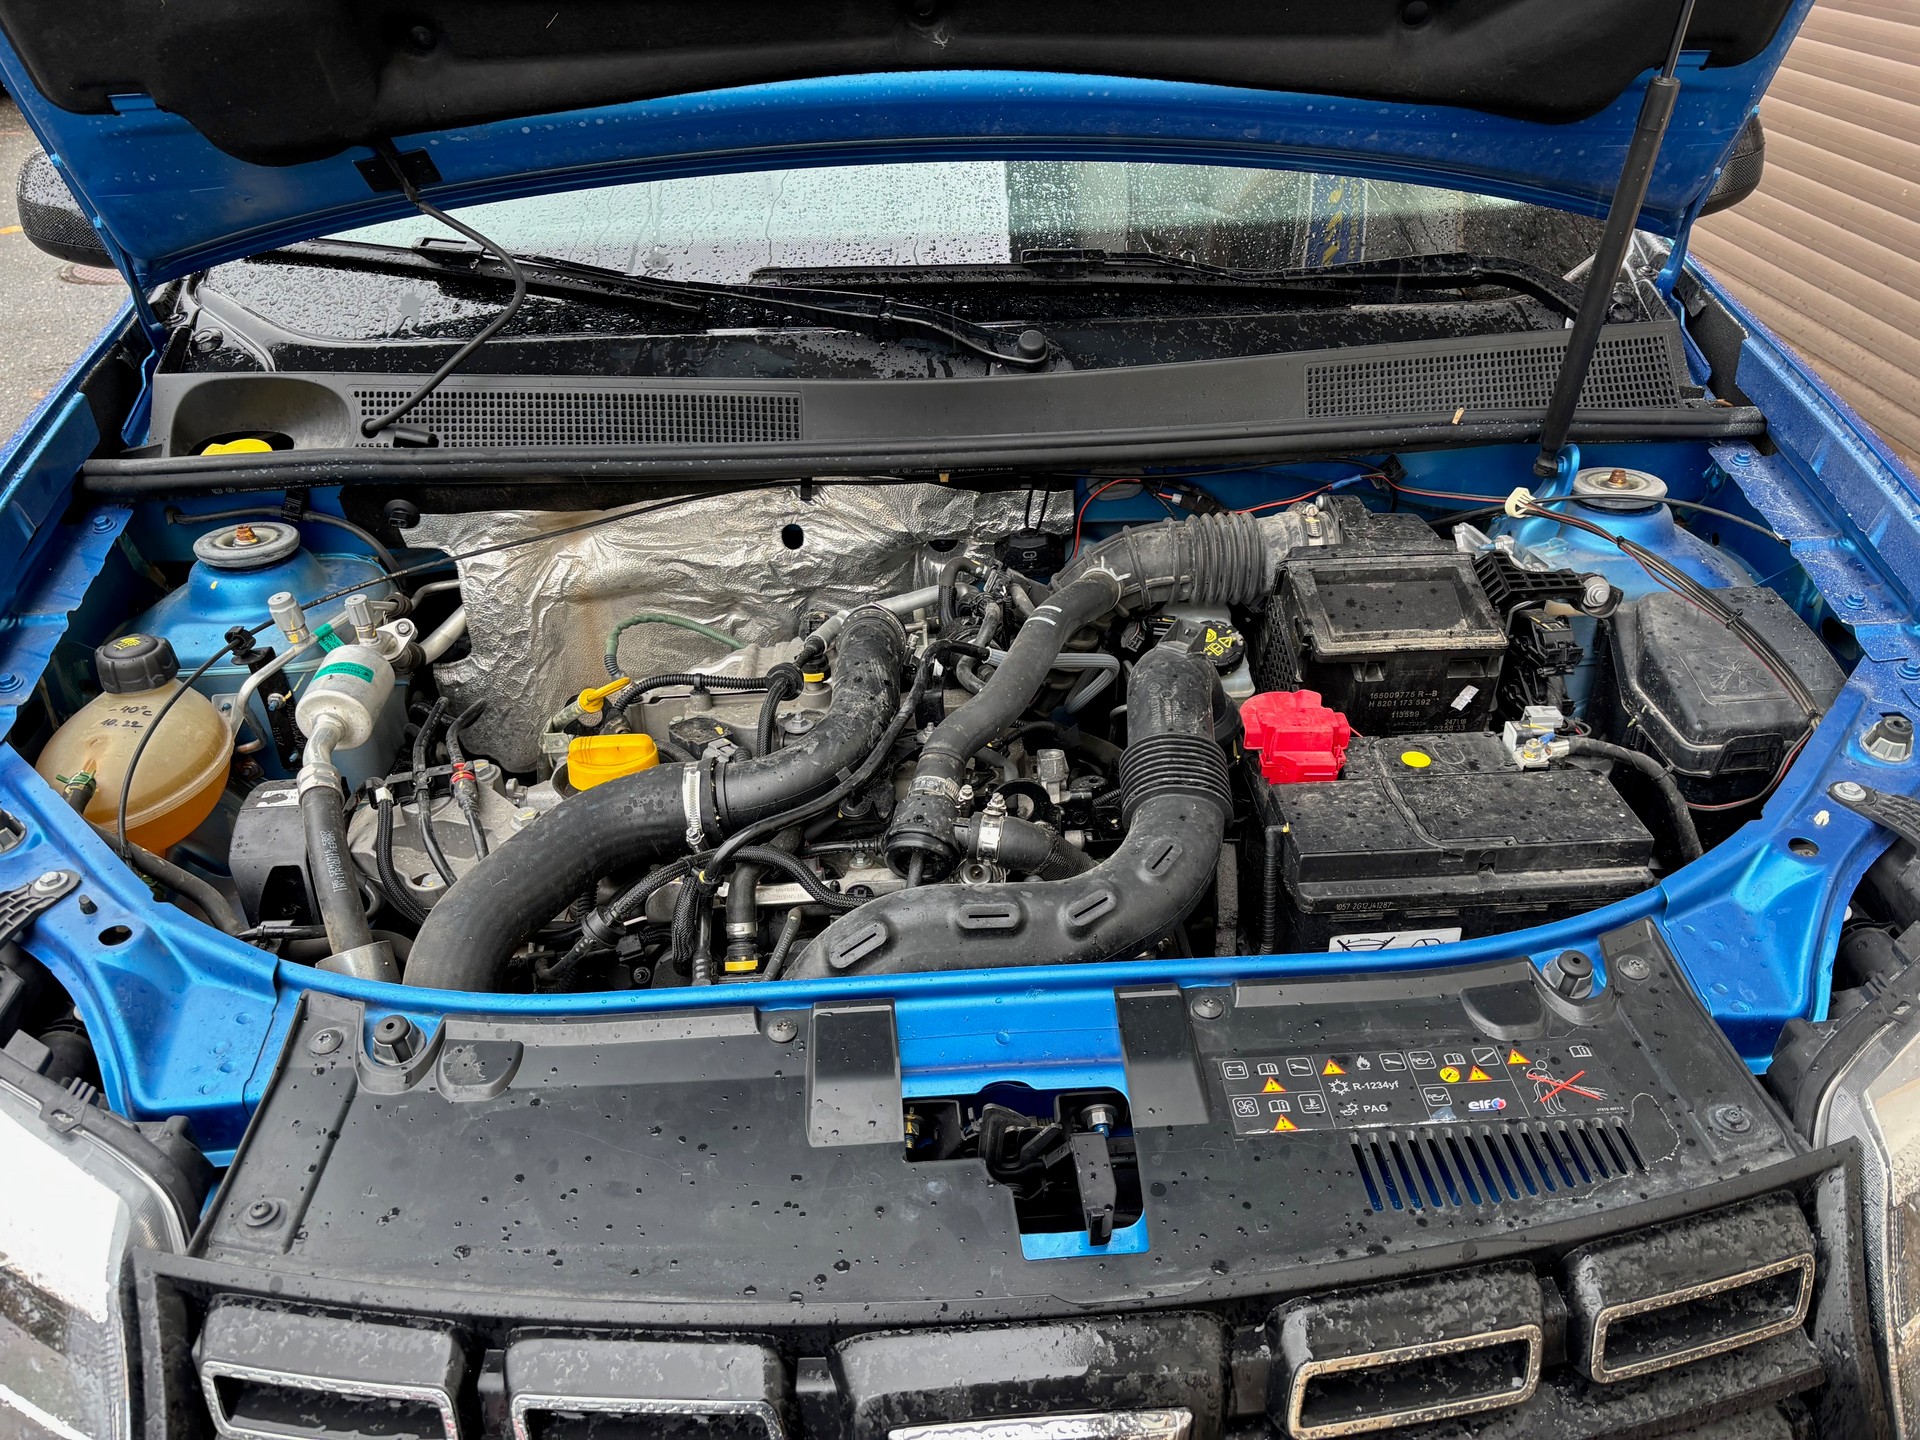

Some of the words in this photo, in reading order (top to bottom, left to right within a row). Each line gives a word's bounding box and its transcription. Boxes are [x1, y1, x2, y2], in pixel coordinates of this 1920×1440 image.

[1352, 1080, 1400, 1091] R-1234yf
[1362, 1103, 1389, 1113] PAG
[1468, 1098, 1491, 1110] elf
